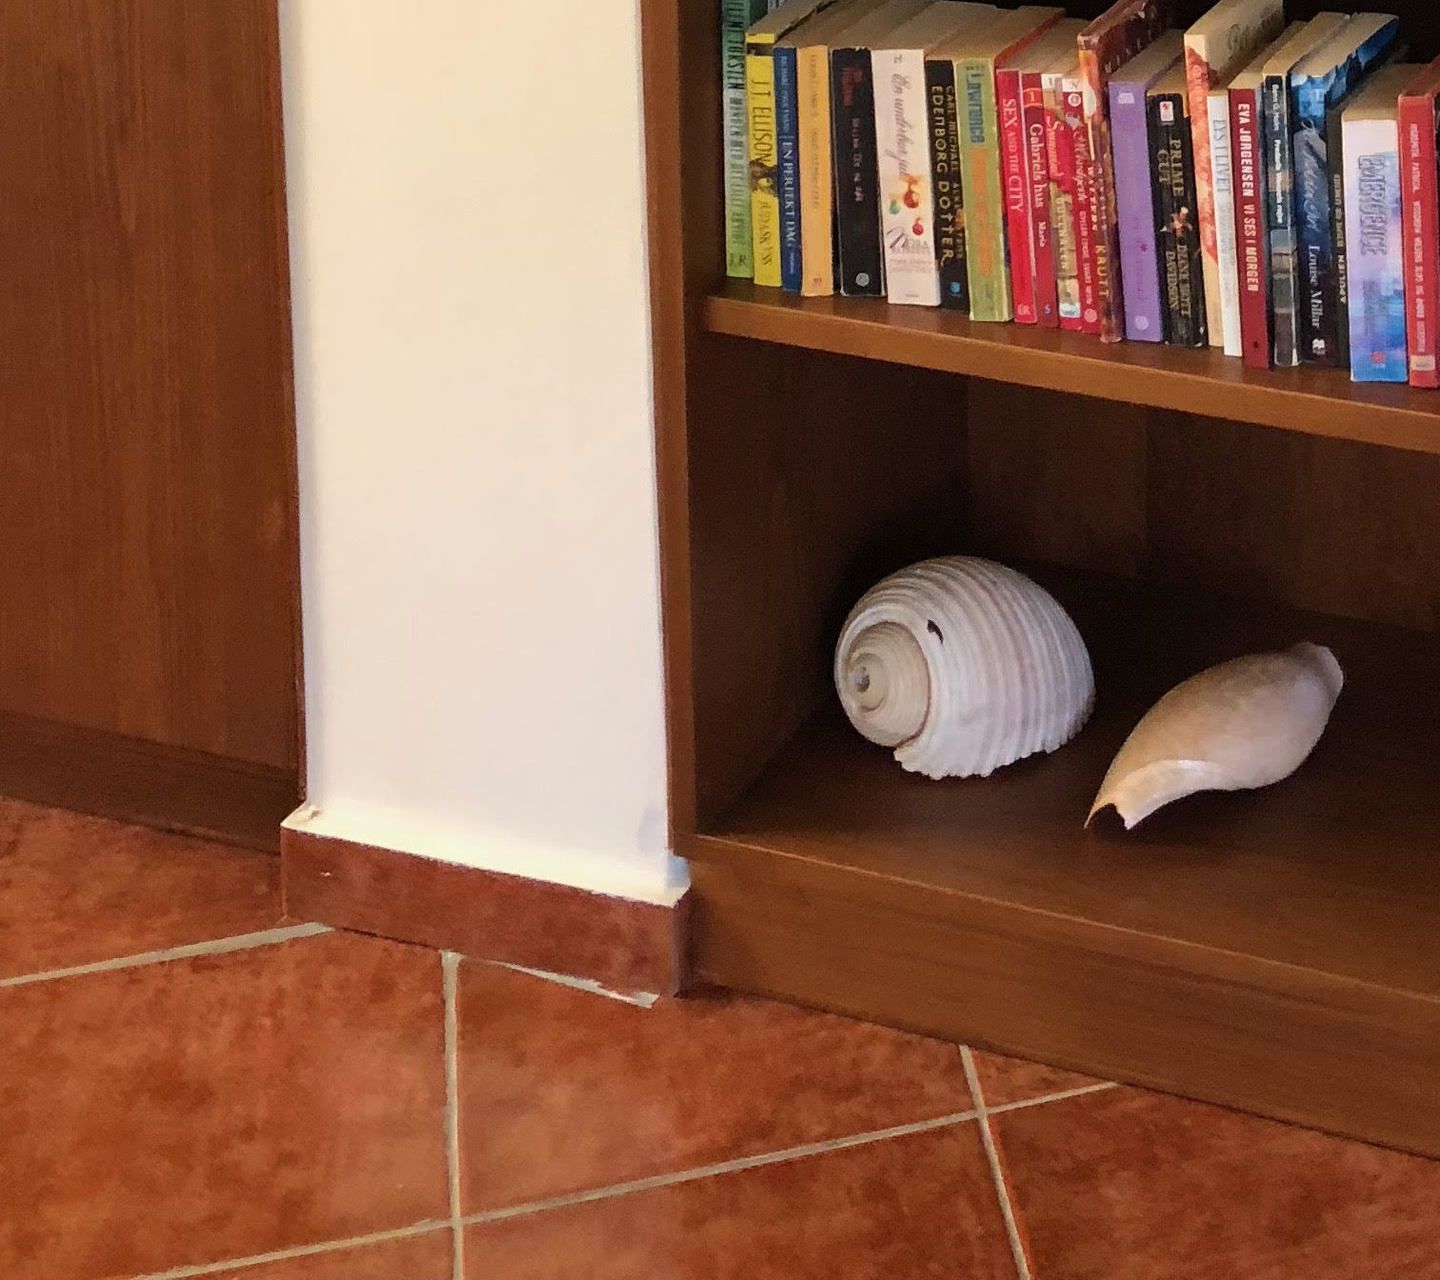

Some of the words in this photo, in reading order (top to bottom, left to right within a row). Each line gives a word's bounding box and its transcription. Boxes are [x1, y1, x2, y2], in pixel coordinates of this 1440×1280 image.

[931, 85, 948, 173] EDENBORG
[1002, 98, 1017, 128] SEX
[1237, 103, 1250, 125] EVA
[753, 106, 775, 165] ELLISON
[1006, 131, 1016, 152] AND
[1028, 123, 1044, 181] Gabriels
[1008, 155, 1018, 174] THE
[1156, 150, 1171, 186] CUT
[1168, 138, 1184, 197] PRIME
[1239, 127, 1254, 197] JØRGENSEN
[1008, 175, 1023, 212] CITY
[1032, 184, 1047, 208] hus
[1243, 204, 1255, 215] VI
[1358, 155, 1386, 256] EMERGENCE
[936, 181, 954, 259] DOTTER
[1037, 221, 1048, 248] Maria
[1244, 217, 1256, 236] SES
[1095, 244, 1108, 298] KRUTT
[1165, 251, 1180, 309] DAVIDSON
[1245, 246, 1258, 292] MORGEN
[1307, 244, 1321, 285] Louise
[1337, 255, 1347, 303] APULIEN
[1309, 289, 1323, 329] Millar
